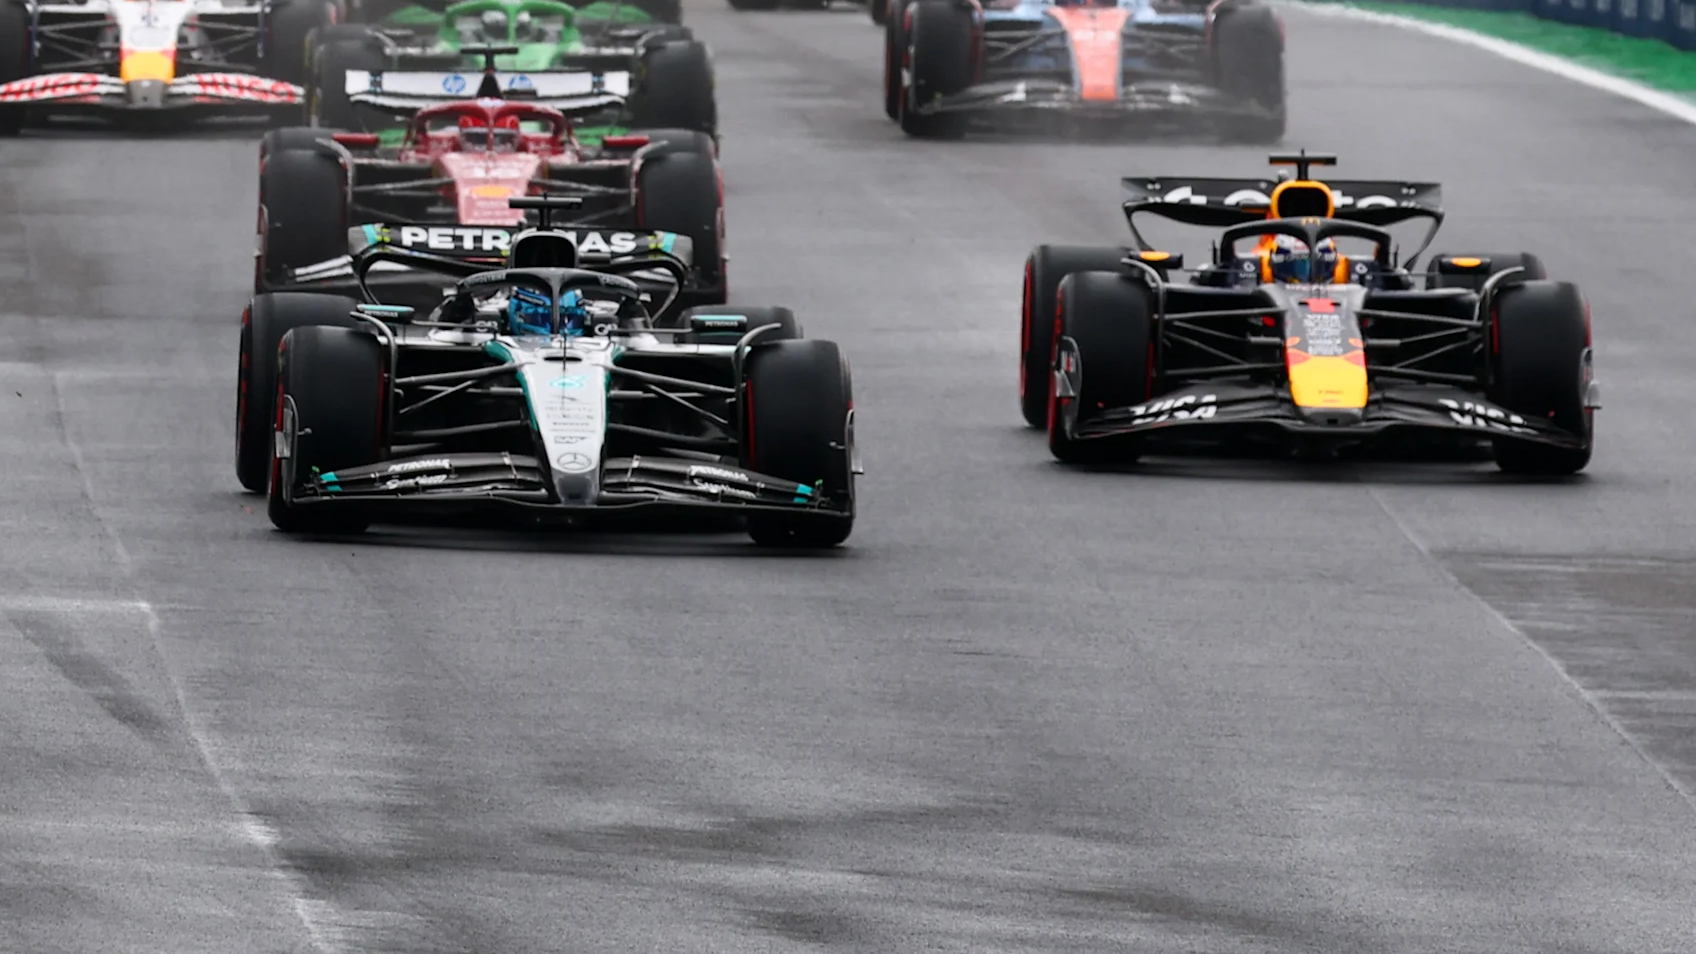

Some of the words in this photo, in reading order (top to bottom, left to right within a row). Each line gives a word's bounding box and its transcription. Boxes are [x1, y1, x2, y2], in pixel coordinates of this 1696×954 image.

[401, 226, 637, 253] PETRAS
[1130, 394, 1218, 425] VISA
[389, 458, 450, 473] PETRONAS
[690, 465, 749, 481] PETRONAS
